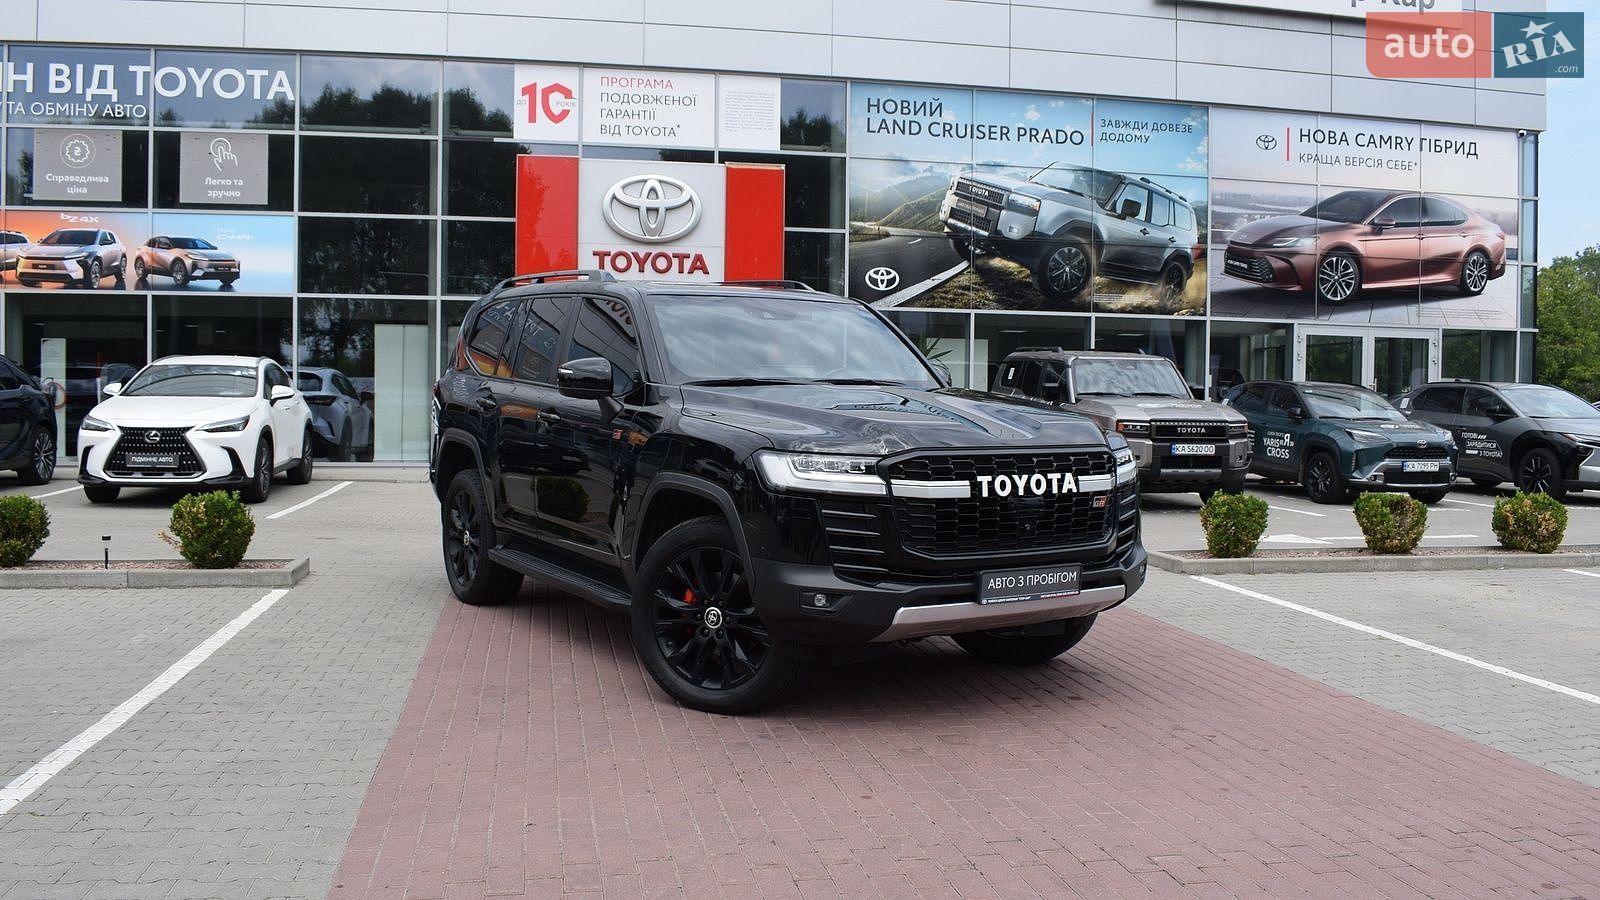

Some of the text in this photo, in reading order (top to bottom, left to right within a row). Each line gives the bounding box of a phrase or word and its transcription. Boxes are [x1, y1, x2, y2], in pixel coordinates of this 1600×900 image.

[49, 63, 118, 102] ВІД
[128, 65, 295, 101] TOYOTA
[600, 76, 674, 90] ПРОГРАМА
[600, 92, 698, 107] ПОДОВЖЕНОЇ
[866, 97, 943, 119] НОВИЙ
[6, 101, 147, 118] ТА ОБМІНУ АВТО
[600, 107, 657, 121] ГАРАНТІЇ
[600, 124, 622, 137] ВІД
[866, 118, 1085, 146] LAND CRUISER PRADO
[1100, 118, 1193, 134] ЗАВЖДИ ДОВЕЗЕ
[1100, 132, 1150, 145] ДОДОМУ
[1299, 128, 1479, 159] НОВА CAMRY ГІБРИД
[1299, 153, 1342, 167] КРАЩА
[1344, 156, 1384, 170] ВЕРСІЯ
[46, 173, 110, 184] Справедлива
[592, 250, 709, 275] TOYOTA
[1266, 446, 1290, 459] CROSS
[977, 472, 1078, 498] TOYOTA
[987, 576, 1016, 590] АВТО
[1026, 571, 1077, 586] ПРОБІГОМ
